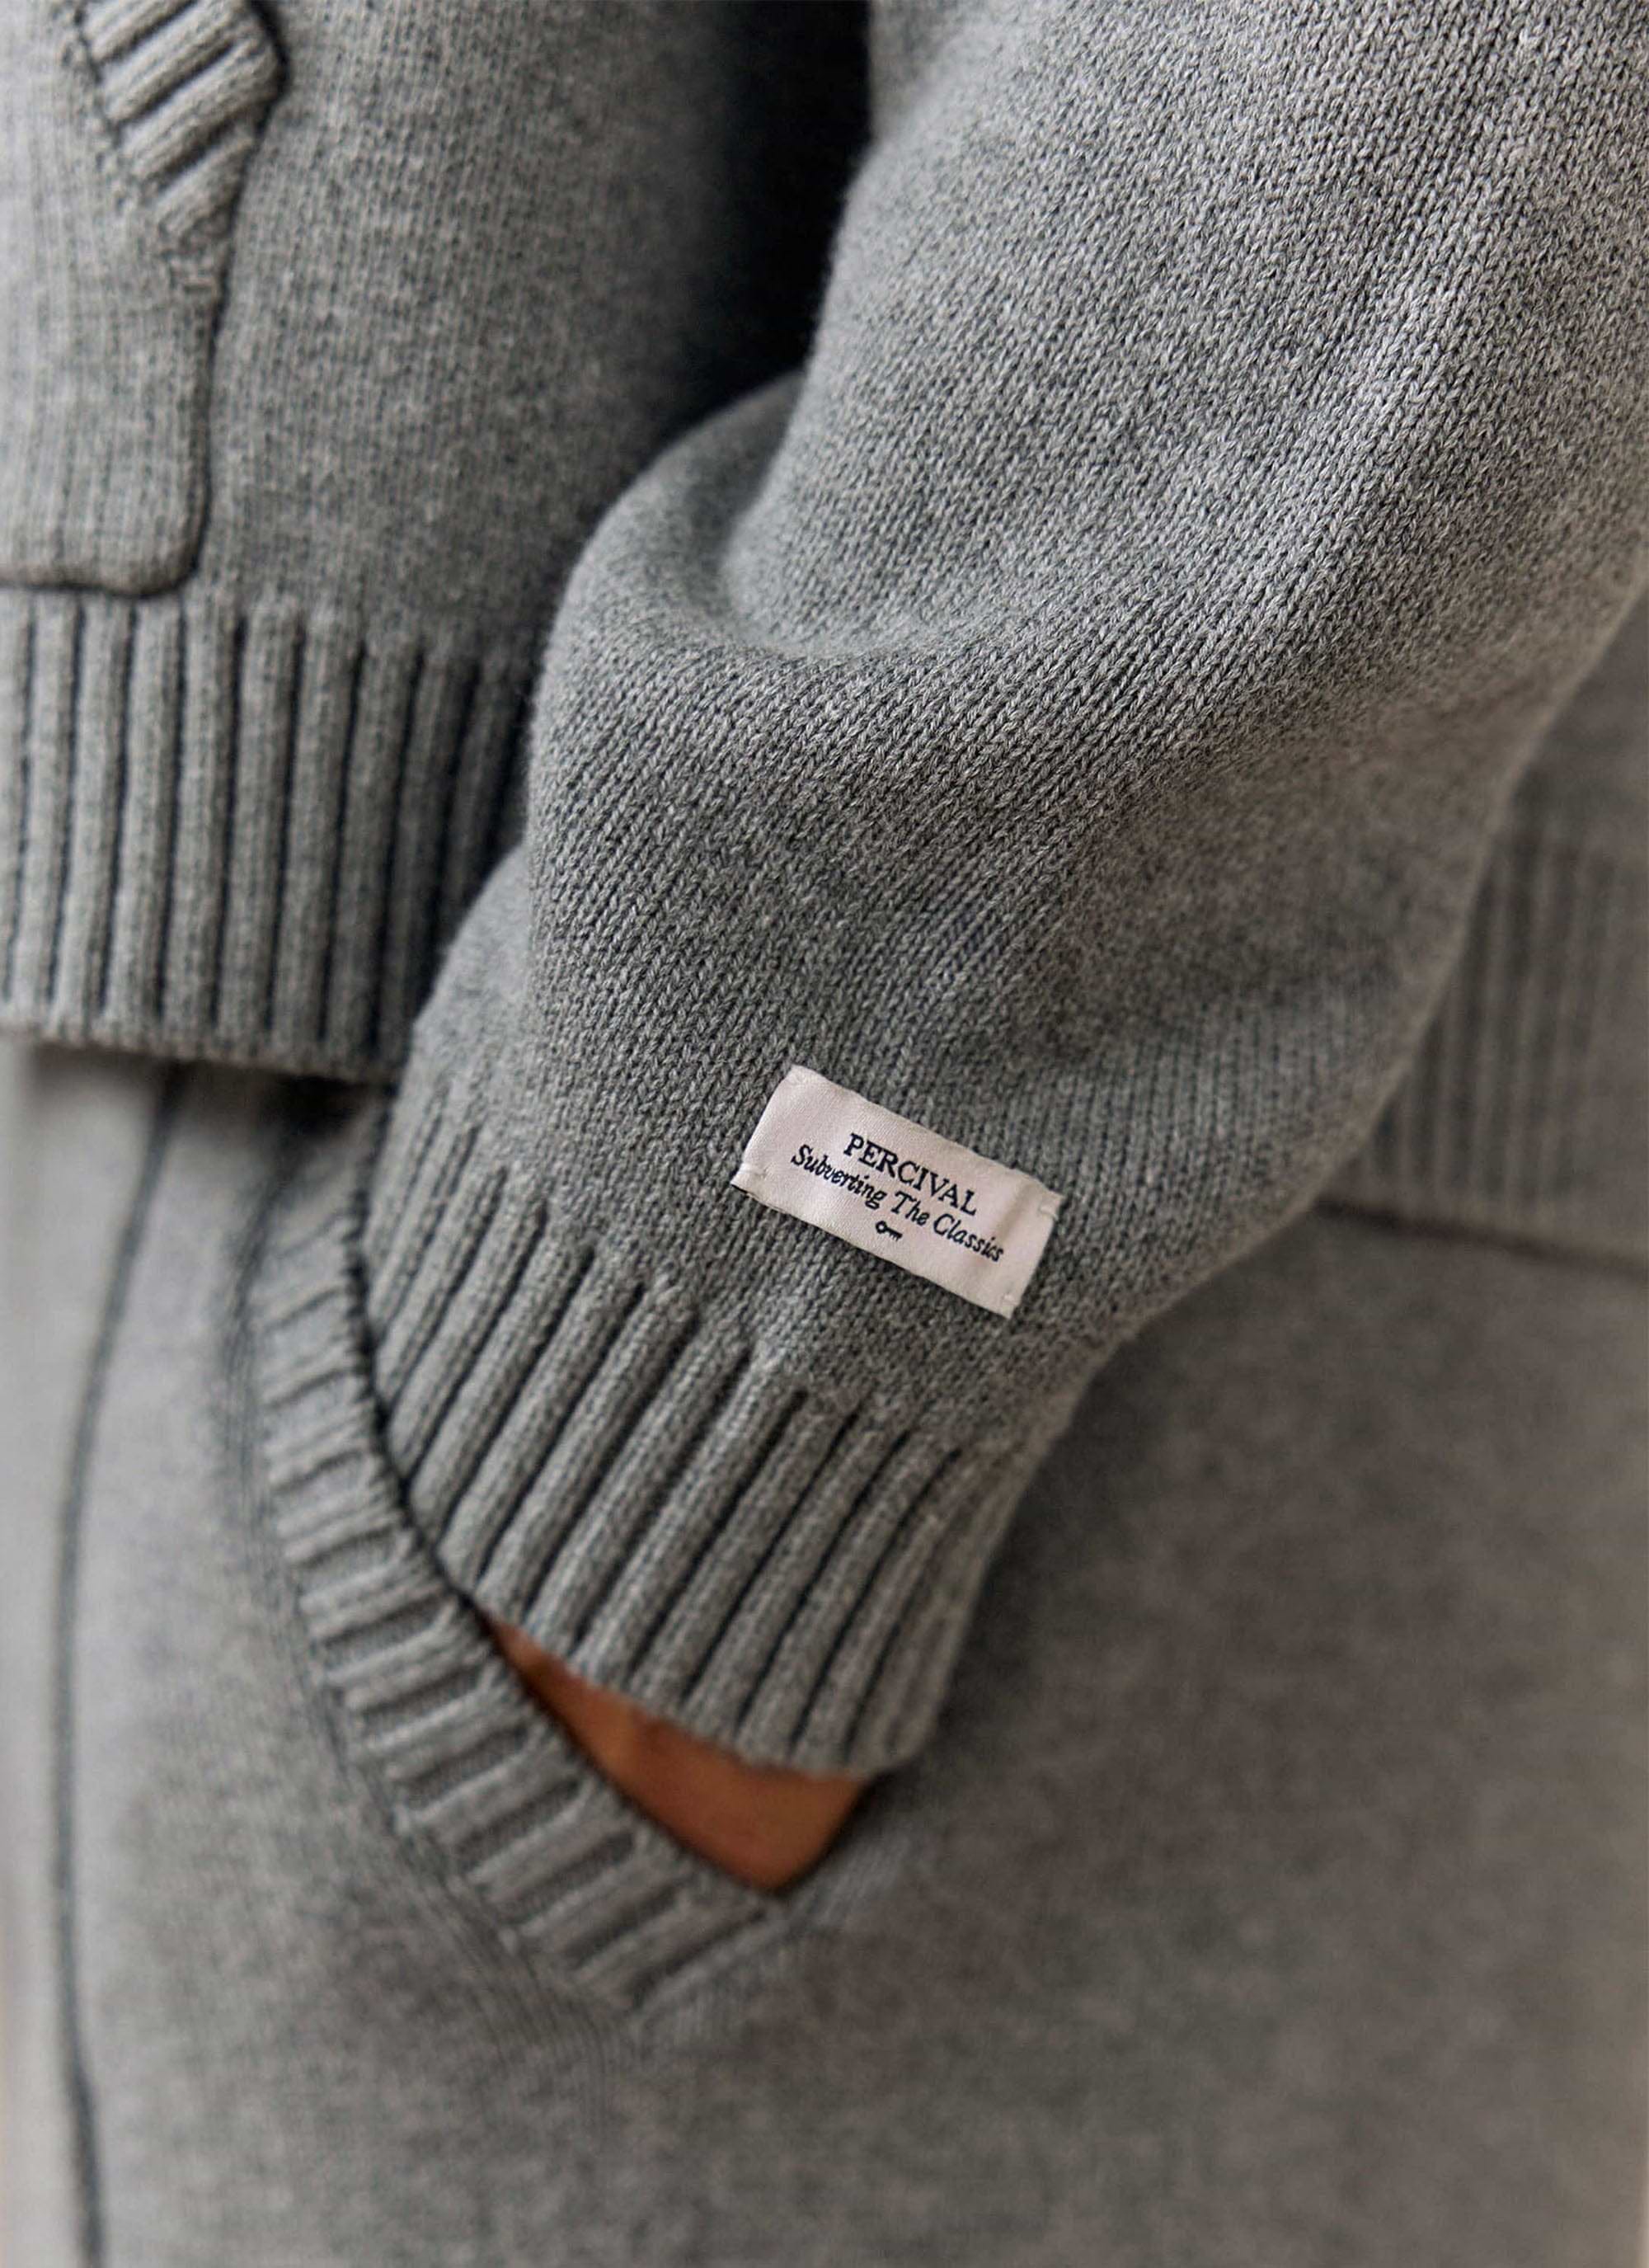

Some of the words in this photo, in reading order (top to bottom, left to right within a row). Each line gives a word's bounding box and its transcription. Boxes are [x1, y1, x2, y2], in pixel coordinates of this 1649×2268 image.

[791, 1144, 887, 1211] Subverting
[890, 1190, 928, 1227] The
[933, 1212, 1004, 1263] Classics
[843, 1132, 977, 1216] PERCIVAL
